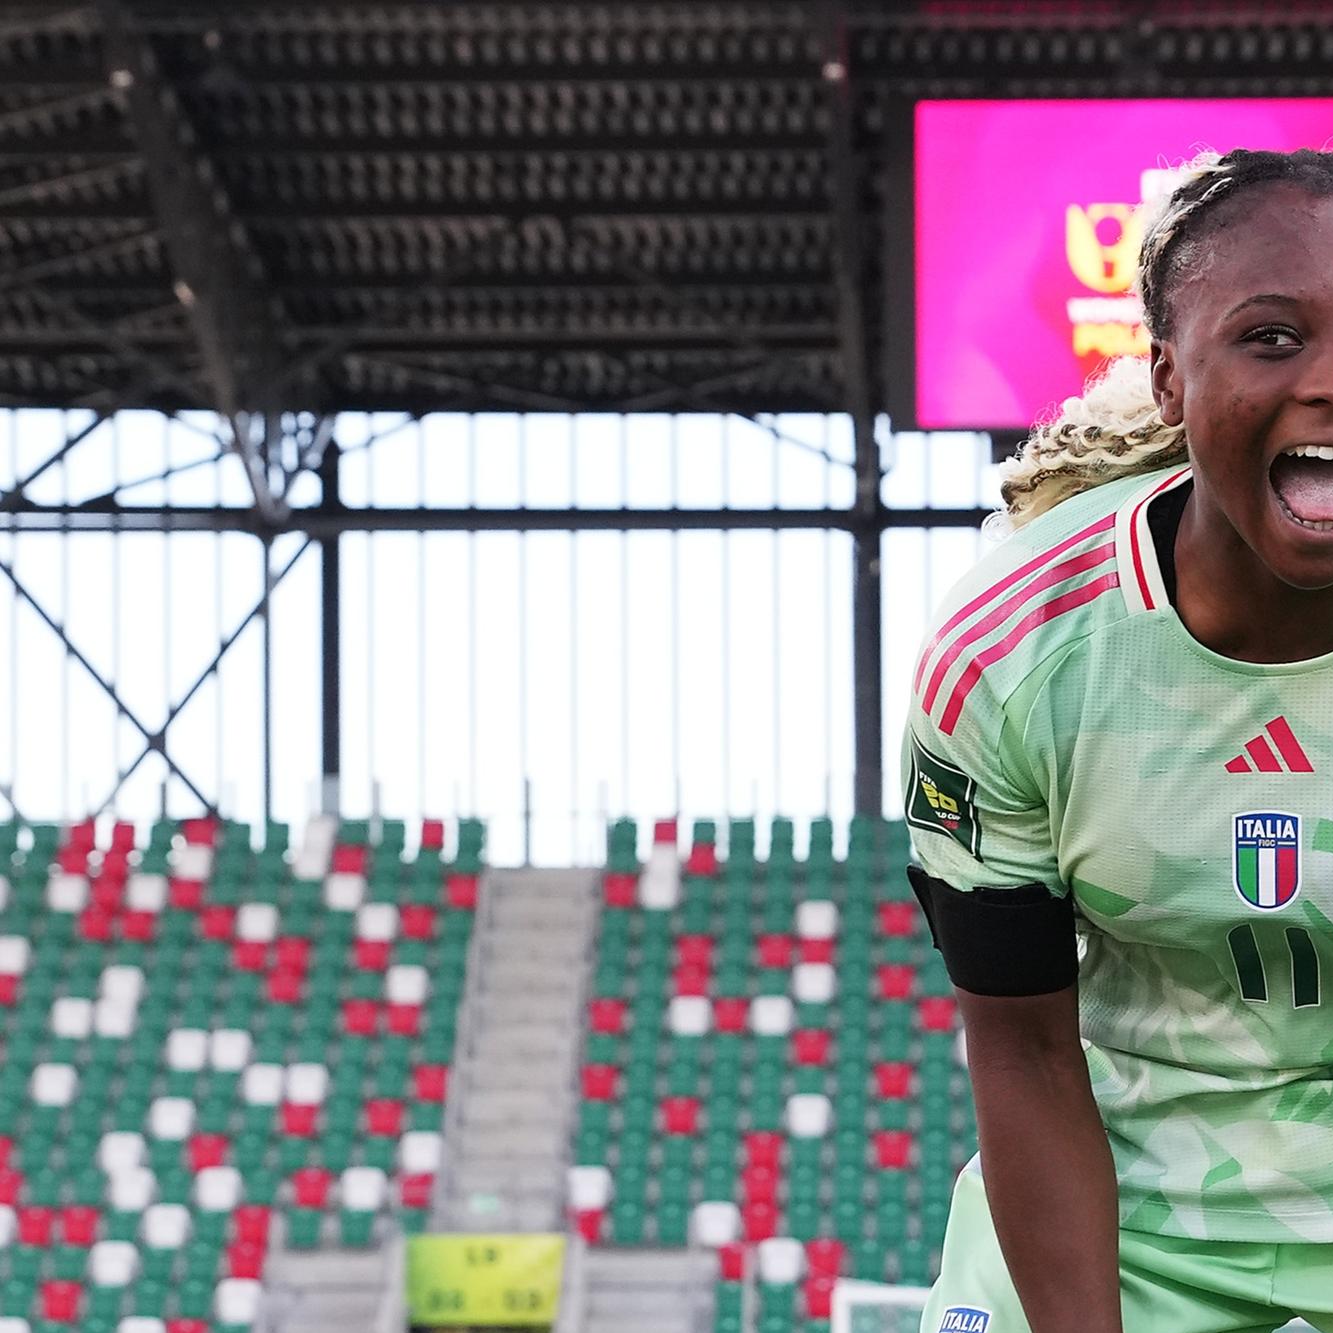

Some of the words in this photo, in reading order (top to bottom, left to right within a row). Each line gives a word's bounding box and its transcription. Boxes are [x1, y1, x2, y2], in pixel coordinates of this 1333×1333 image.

[1237, 819, 1296, 839] ITALIA
[1226, 923, 1321, 1010] 11
[942, 1312, 984, 1333] ITALIA
